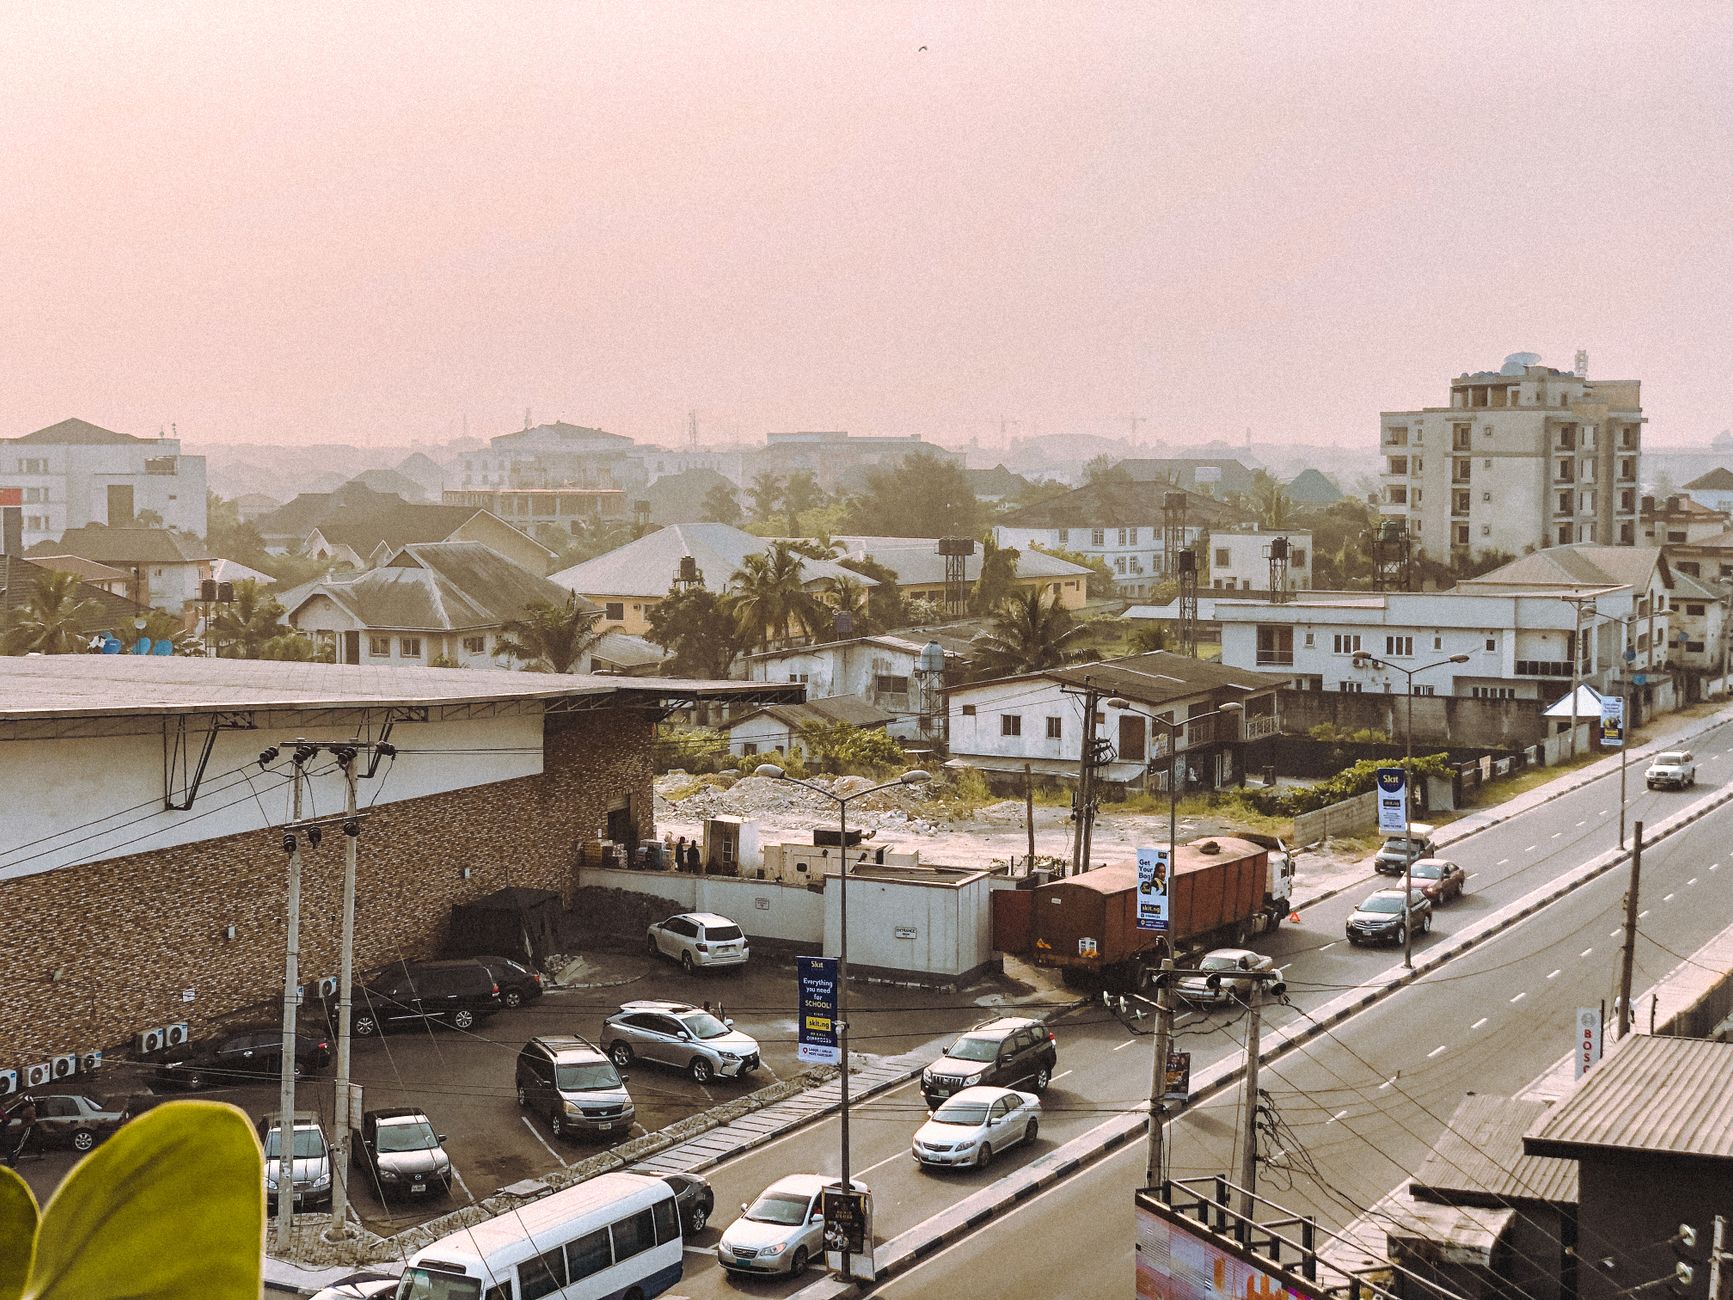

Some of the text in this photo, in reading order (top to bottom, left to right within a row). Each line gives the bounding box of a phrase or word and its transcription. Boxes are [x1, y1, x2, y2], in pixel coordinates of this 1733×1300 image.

[1383, 775, 1399, 783] Skit
[1139, 865, 1153, 873] Your
[1139, 873, 1153, 881] Bag!
[811, 961, 823, 969] Skit
[803, 978, 833, 988] Everything
[805, 999, 832, 1009] SCHOOL!
[809, 1019, 829, 1030] skit.ng
